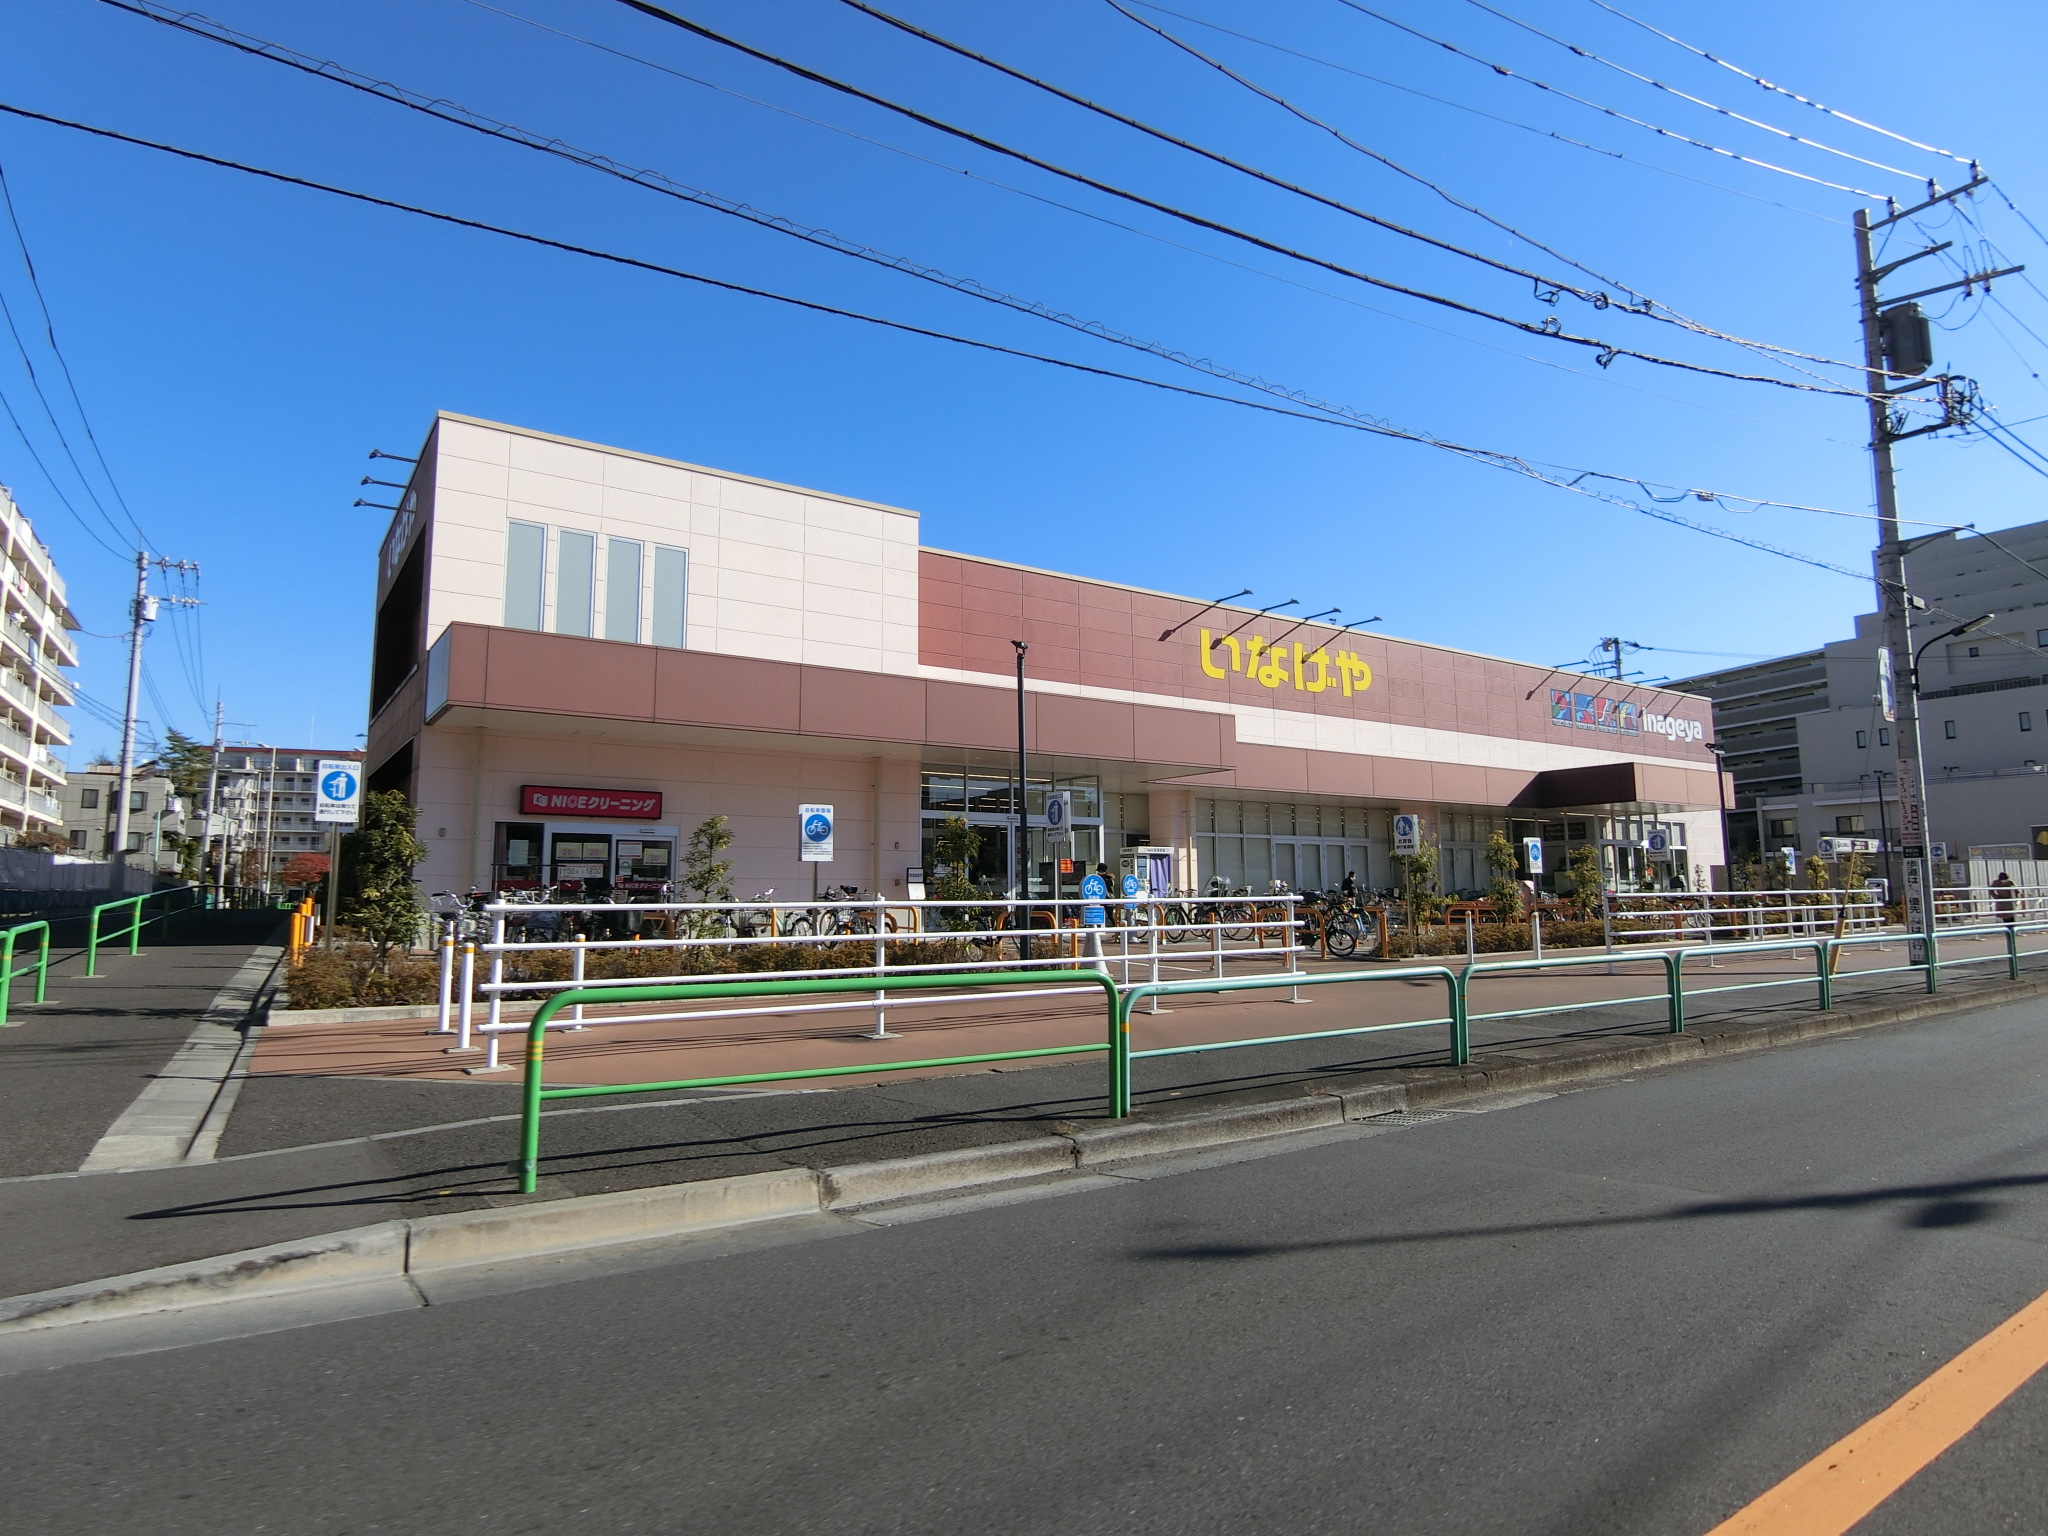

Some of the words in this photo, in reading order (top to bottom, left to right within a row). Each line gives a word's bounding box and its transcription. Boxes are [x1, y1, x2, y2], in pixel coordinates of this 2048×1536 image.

[1200, 629, 1372, 698] いなげや
[1641, 706, 1703, 743] inageya
[551, 795, 656, 812] NICEクリーニング
